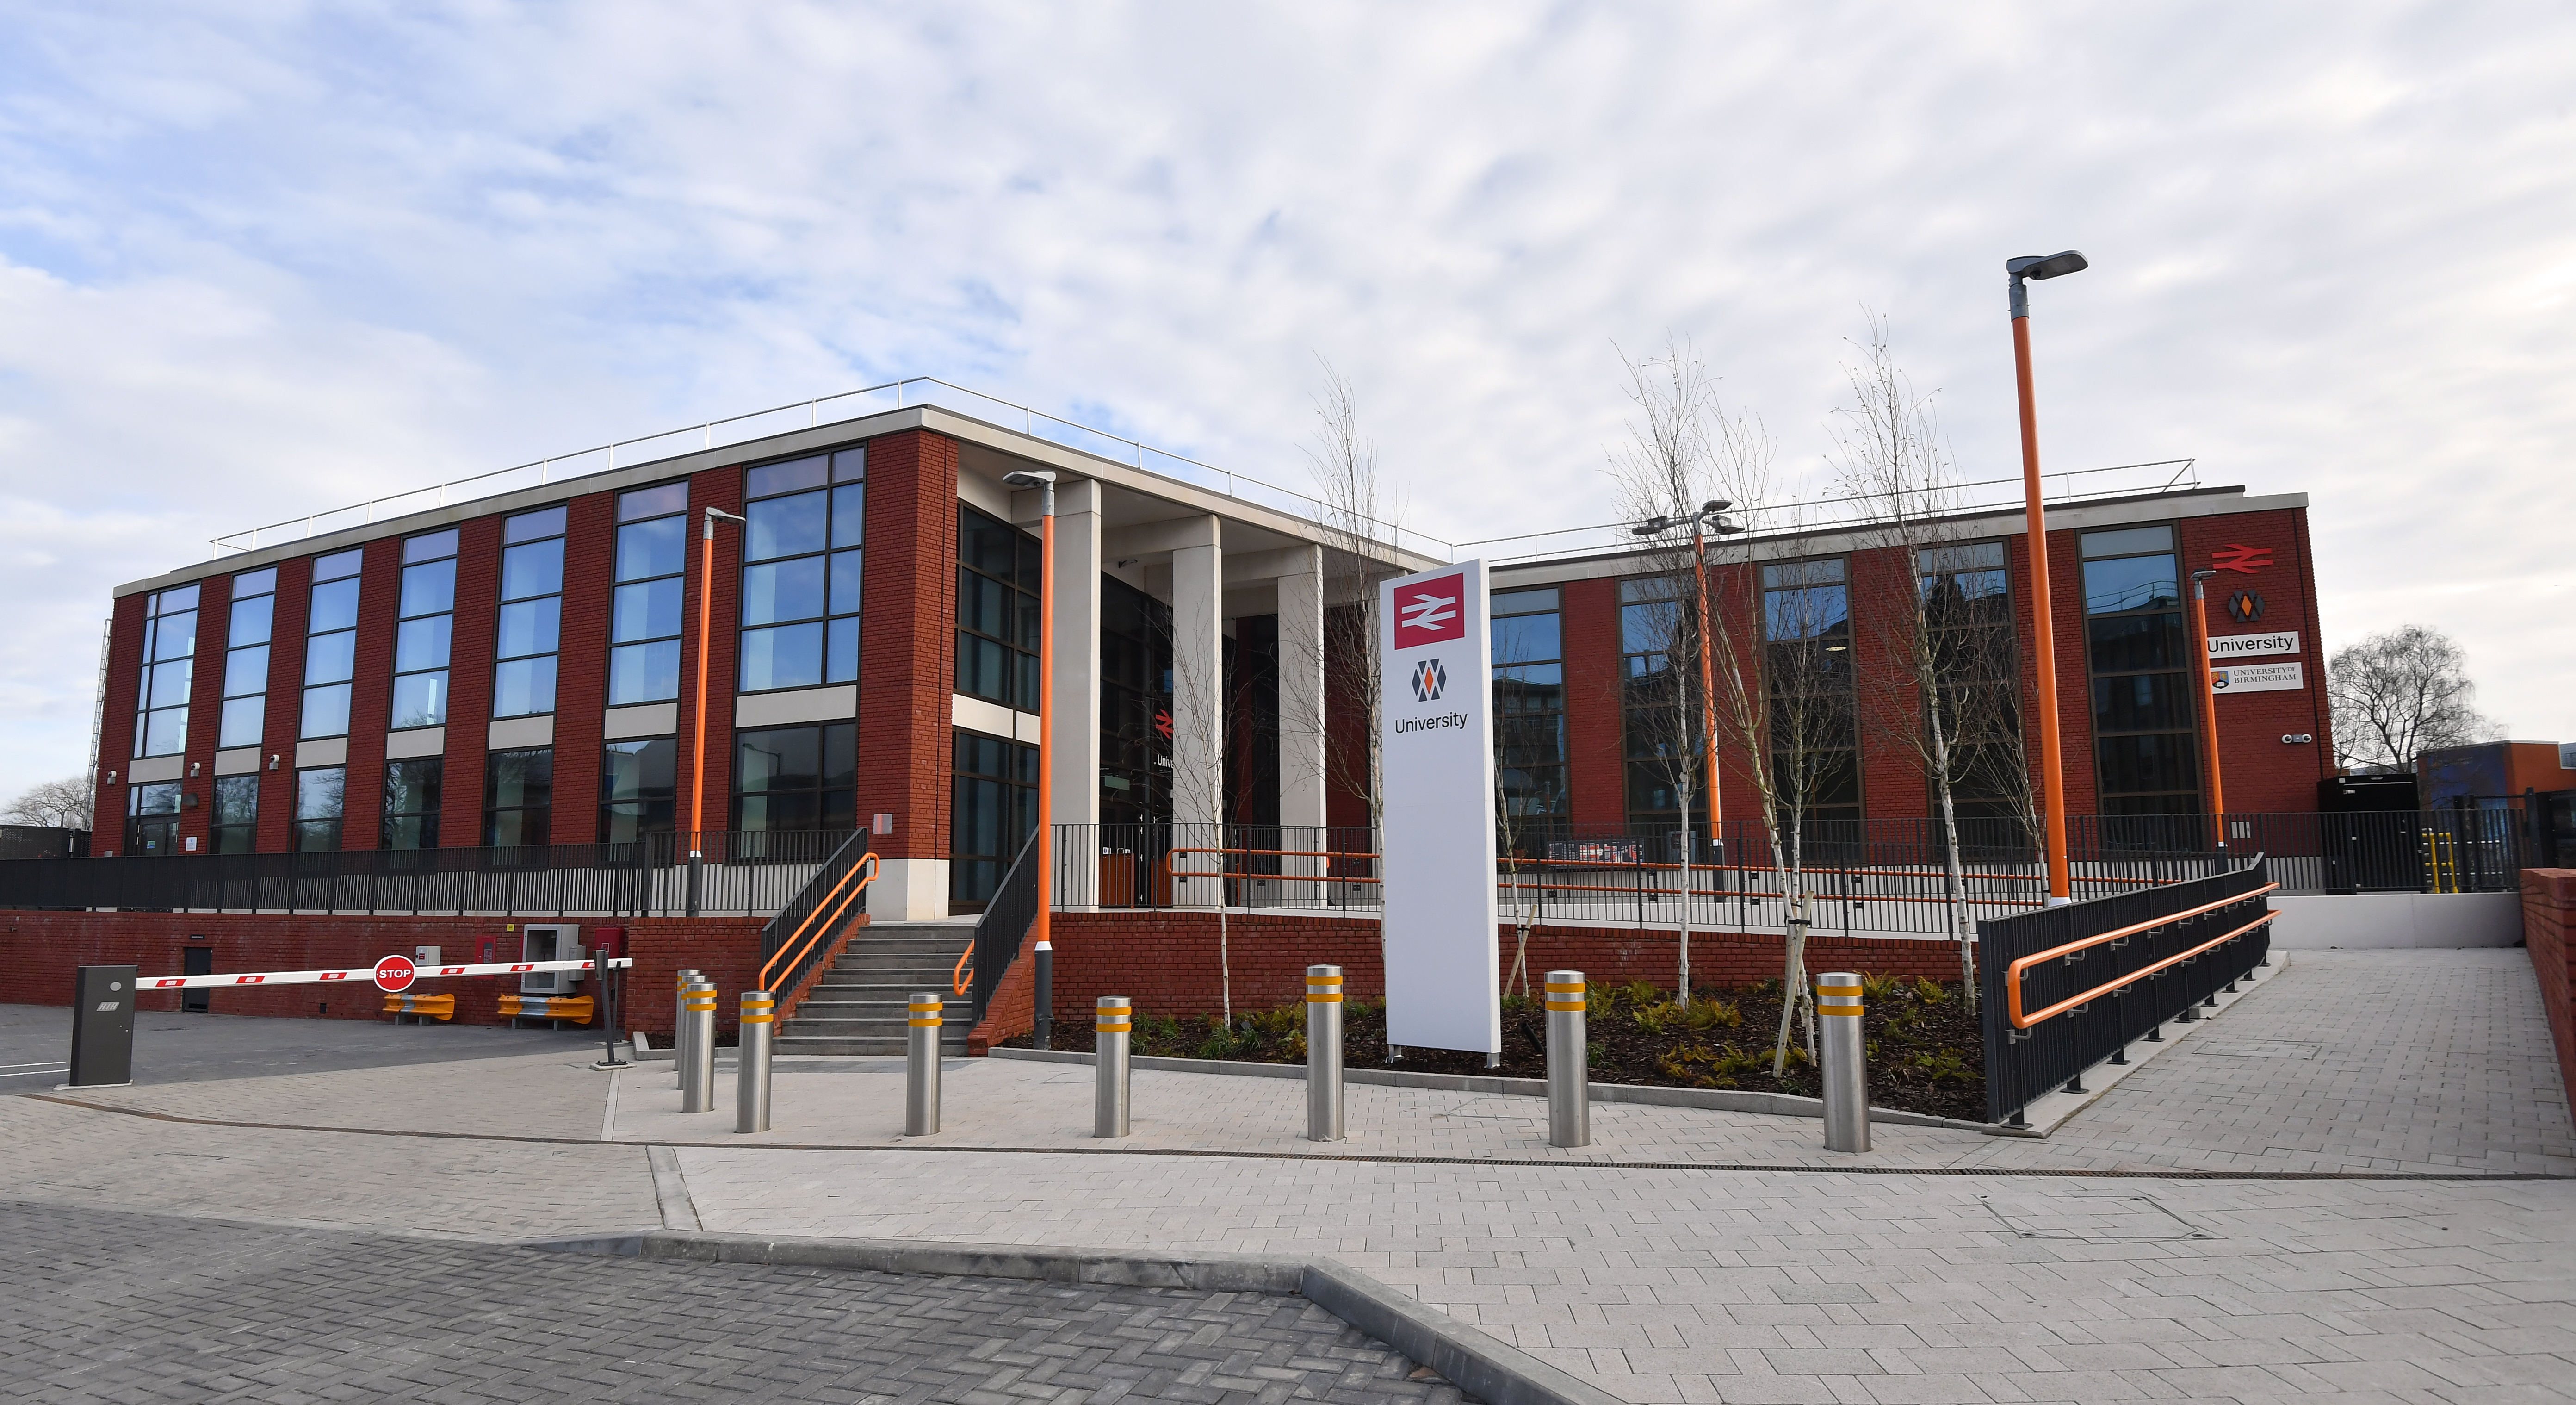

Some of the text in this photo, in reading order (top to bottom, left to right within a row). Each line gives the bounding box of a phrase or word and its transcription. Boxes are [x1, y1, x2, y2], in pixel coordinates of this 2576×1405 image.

[2208, 635, 2294, 653] University
[2234, 667, 2287, 676] UNIVERSITY
[2234, 674, 2296, 684] BIRMINGHAM
[1395, 712, 1468, 734] University
[1158, 754, 1173, 769] Unive
[379, 969, 411, 979] STOP
